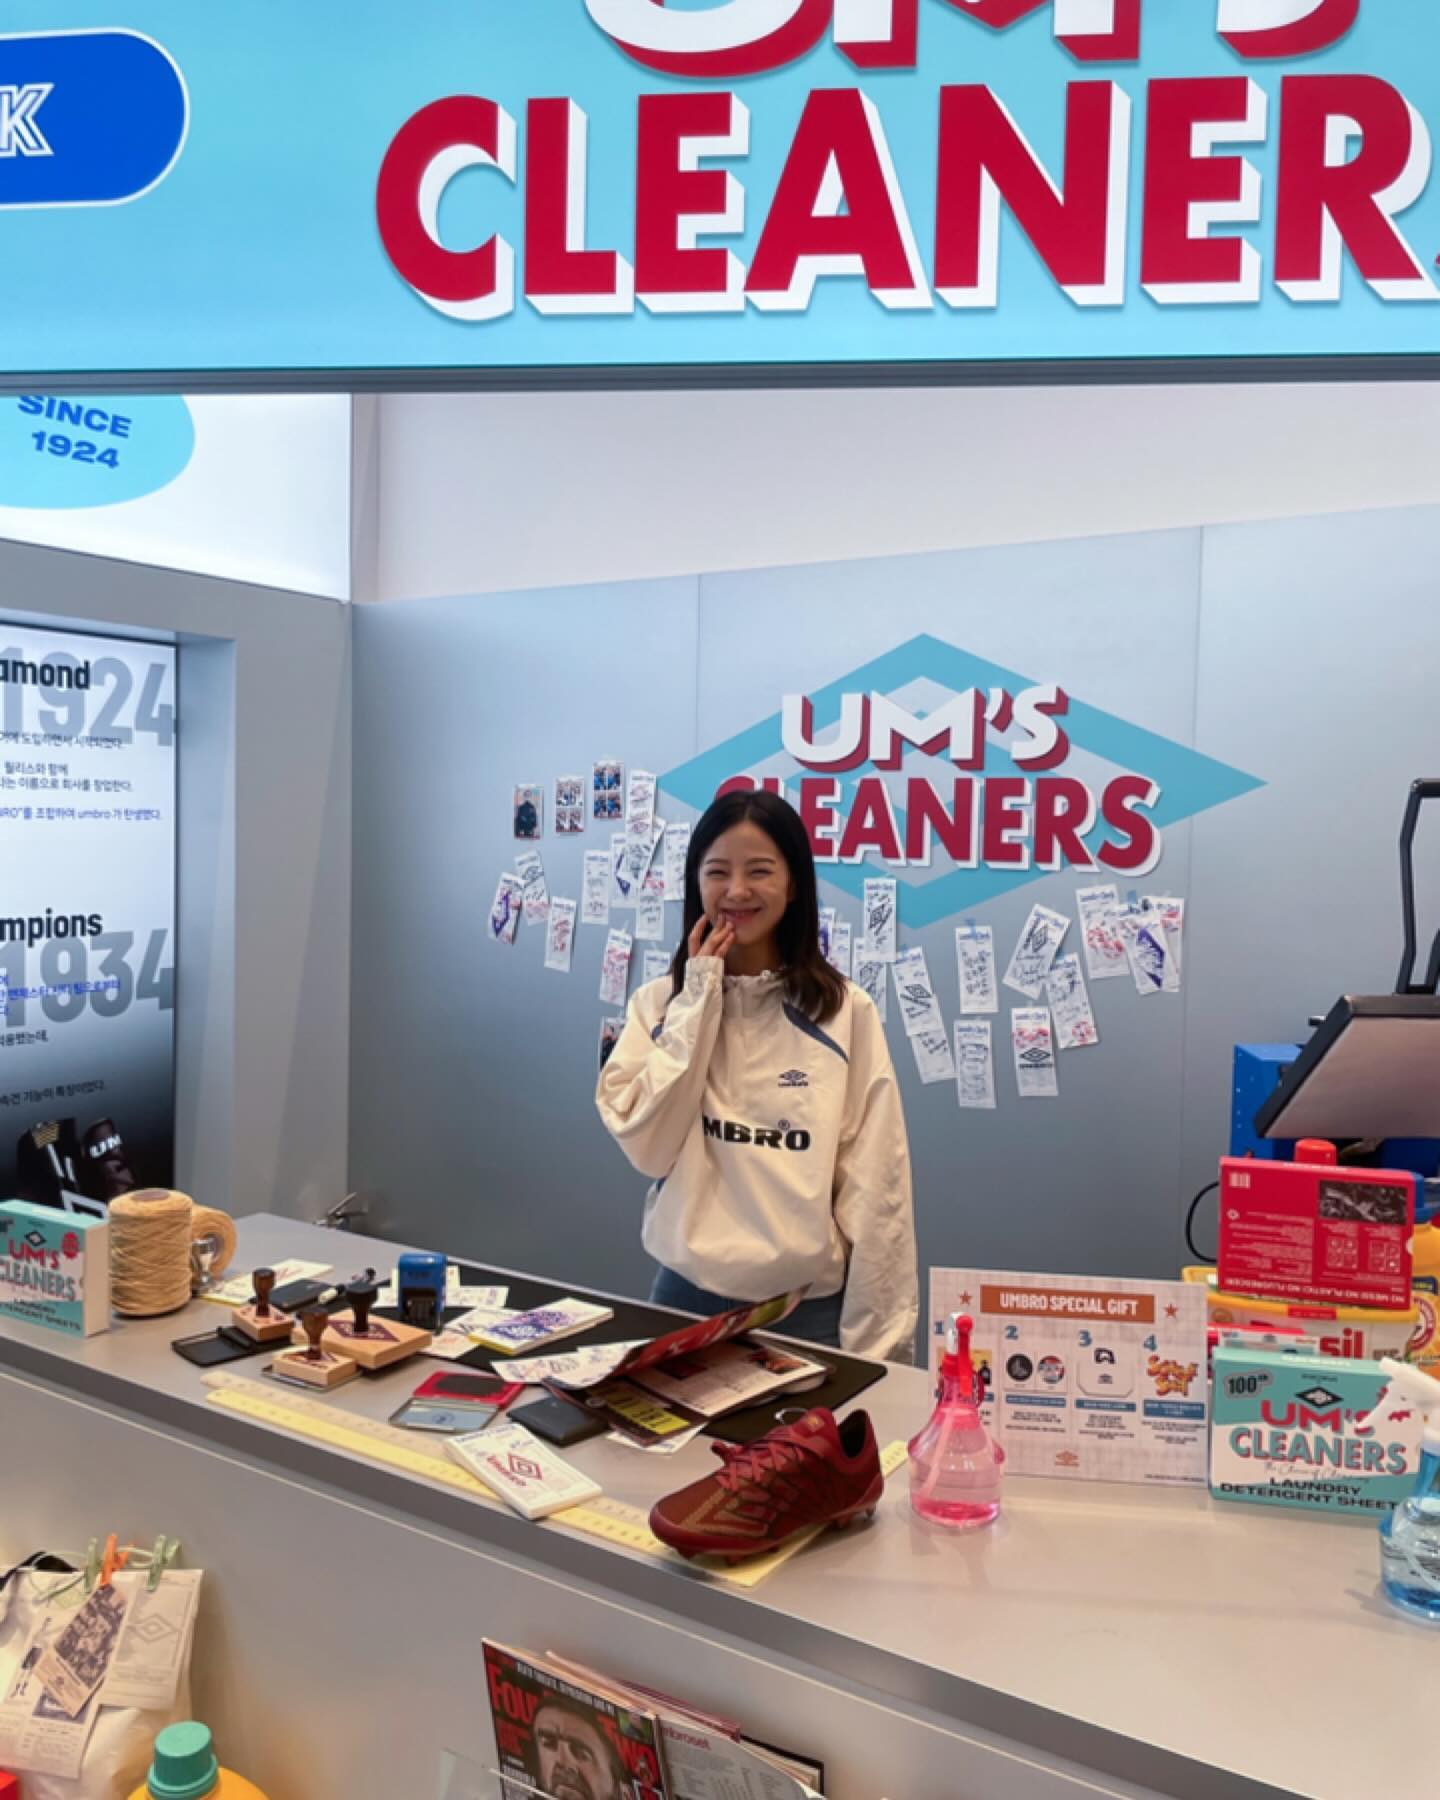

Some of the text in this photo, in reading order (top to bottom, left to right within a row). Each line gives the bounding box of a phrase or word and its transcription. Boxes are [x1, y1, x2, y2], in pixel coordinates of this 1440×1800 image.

[376, 73, 1440, 322] CLEANER
[18, 394, 132, 438] SINCE
[31, 431, 119, 468] 1924
[0, 646, 173, 747] 1924
[780, 683, 1070, 772] UM'S
[714, 775, 1162, 878] EANERS
[1000, 1292, 1139, 1317] UMBRO SPECIAL GIFT
[935, 1320, 944, 1335] 1
[1005, 1325, 1018, 1340] 2
[1078, 1330, 1092, 1347] 3
[1143, 1334, 1158, 1351] 4
[1229, 1426, 1408, 1476] CLEANERS
[1219, 1482, 1335, 1504] DETERGENT
[1269, 1476, 1362, 1497] LAUNDRY
